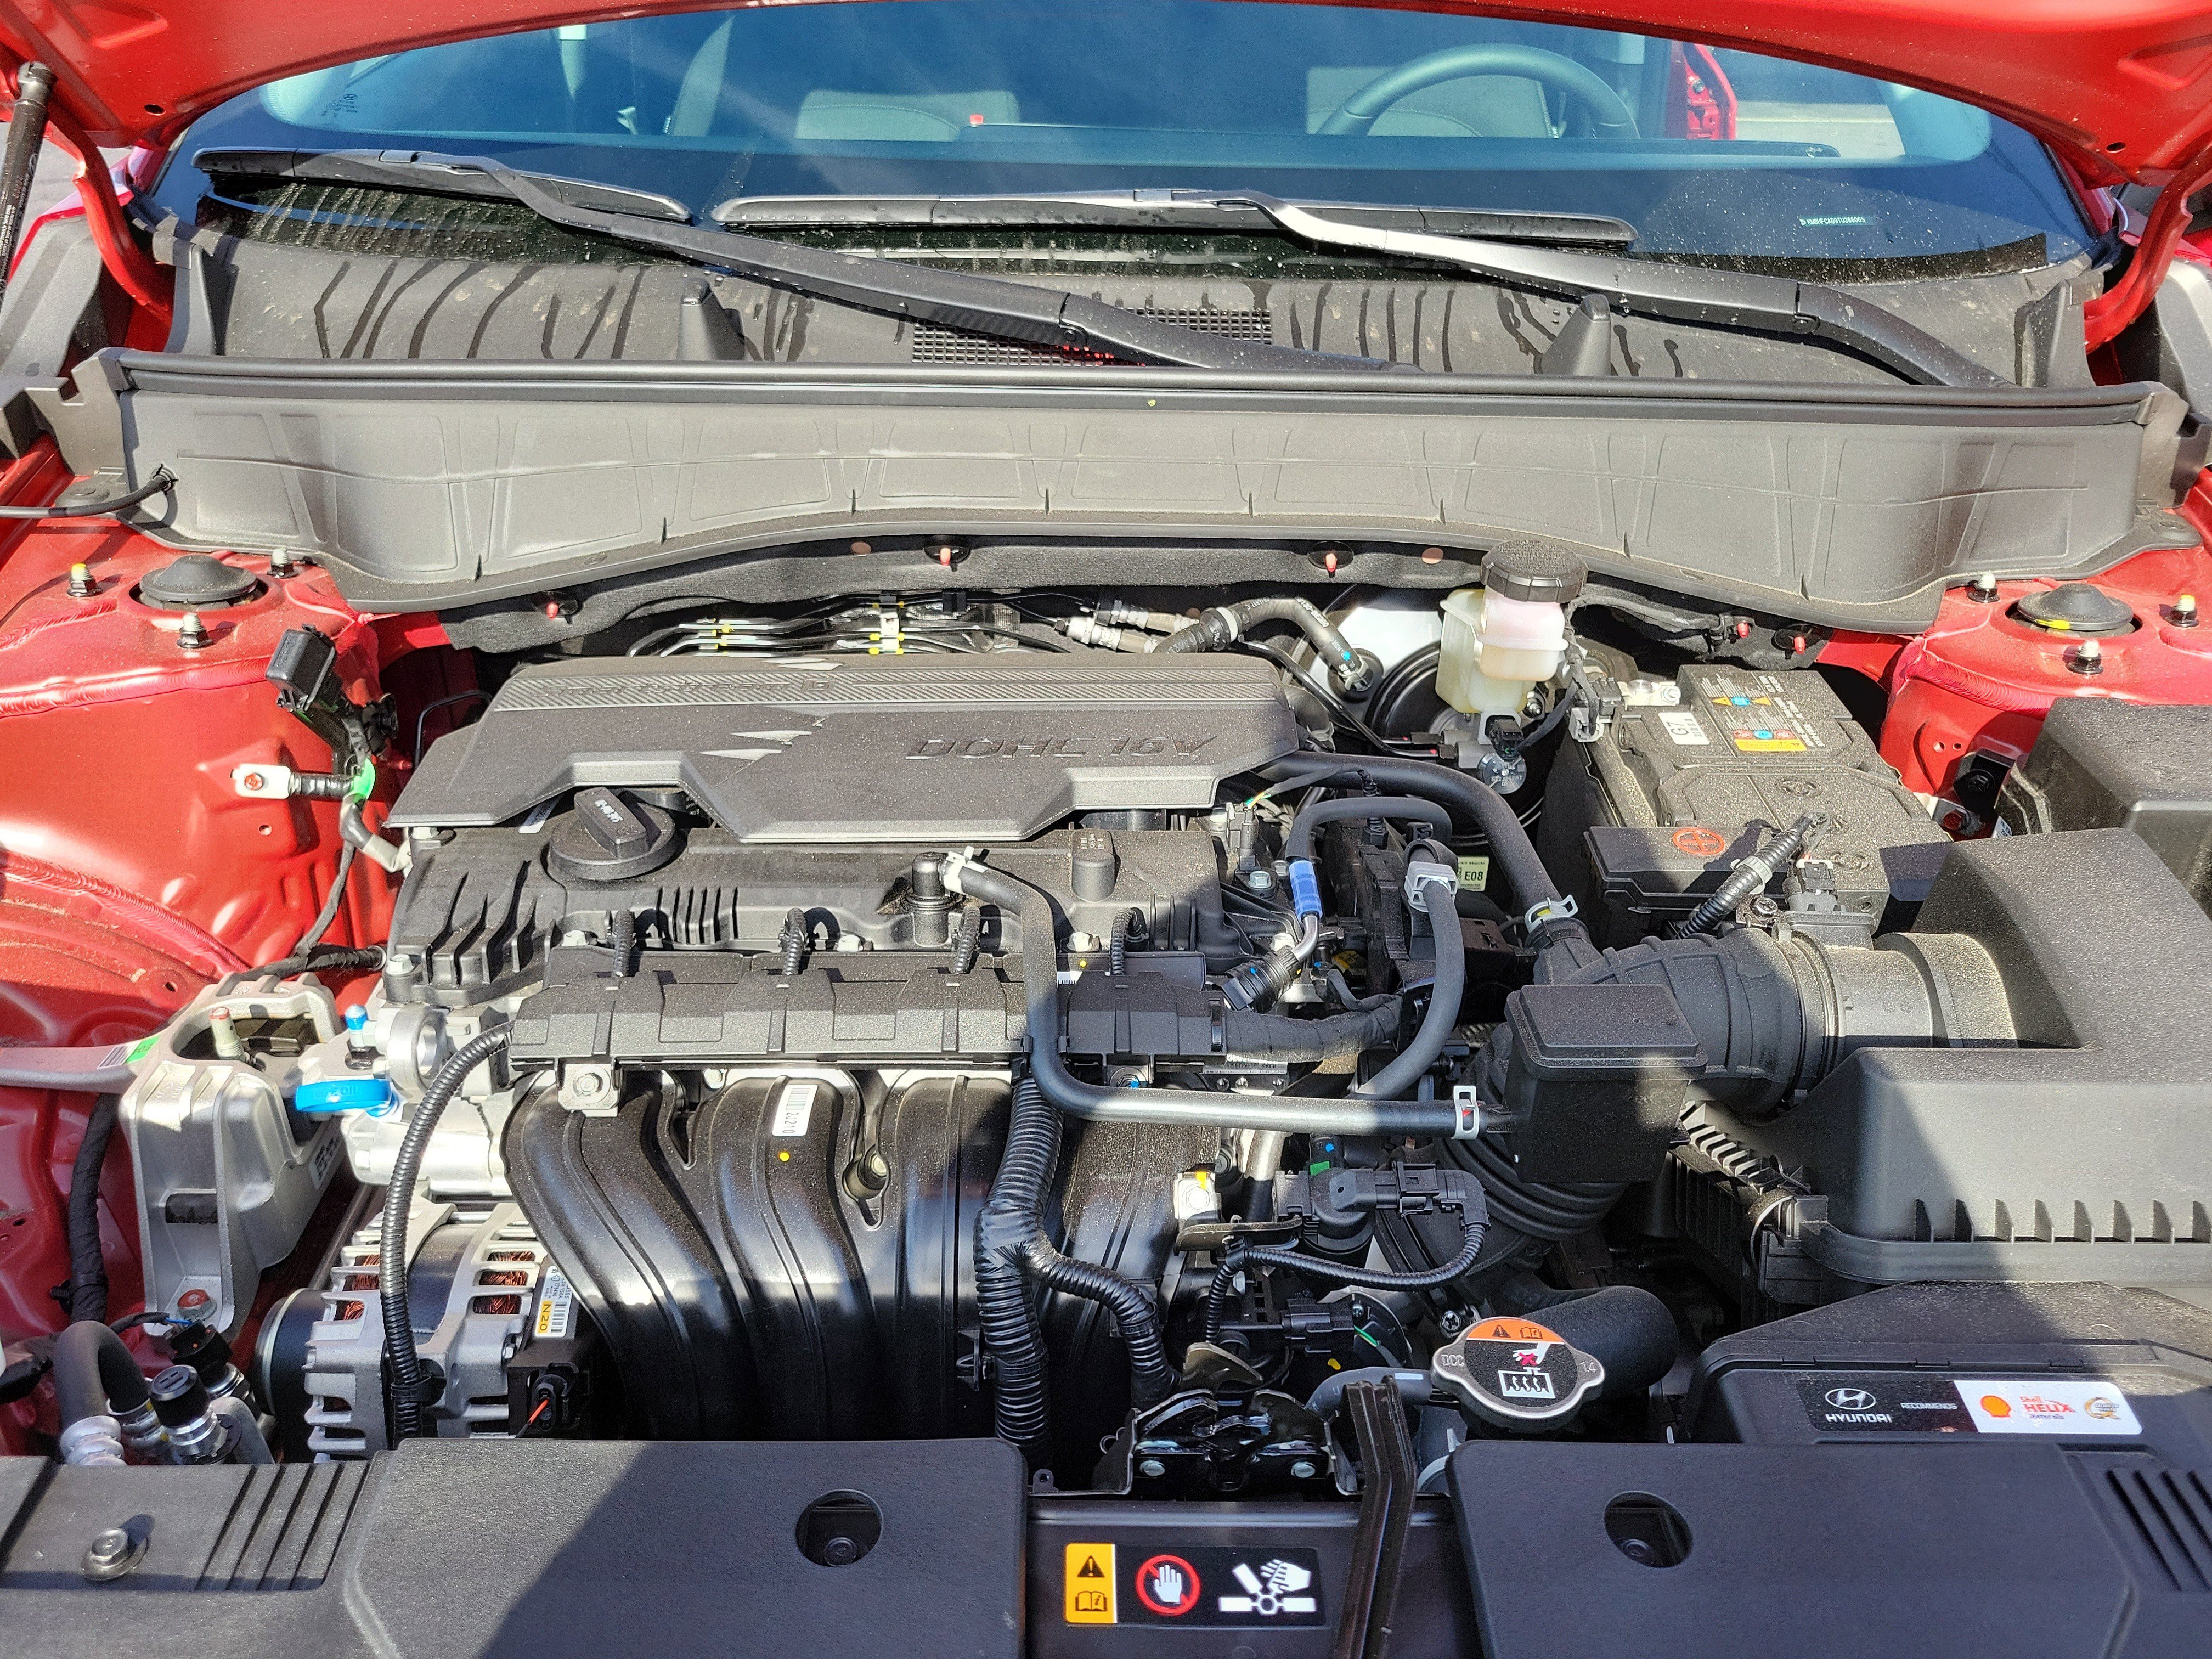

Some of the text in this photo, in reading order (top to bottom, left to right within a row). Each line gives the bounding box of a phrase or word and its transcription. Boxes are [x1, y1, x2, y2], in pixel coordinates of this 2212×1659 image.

[1666, 721, 1689, 735] G7
[905, 736, 1217, 760] DOHC 16V
[1464, 871, 1483, 881] E08
[782, 1112, 799, 1133] 2J210
[540, 1304, 551, 1331] N20
[1441, 1354, 1464, 1367] DCC
[1900, 1402, 1958, 1410] RECOMMENDS
[2023, 1403, 2075, 1413] HELIX
[1825, 1413, 1892, 1423] HYUNDAI
